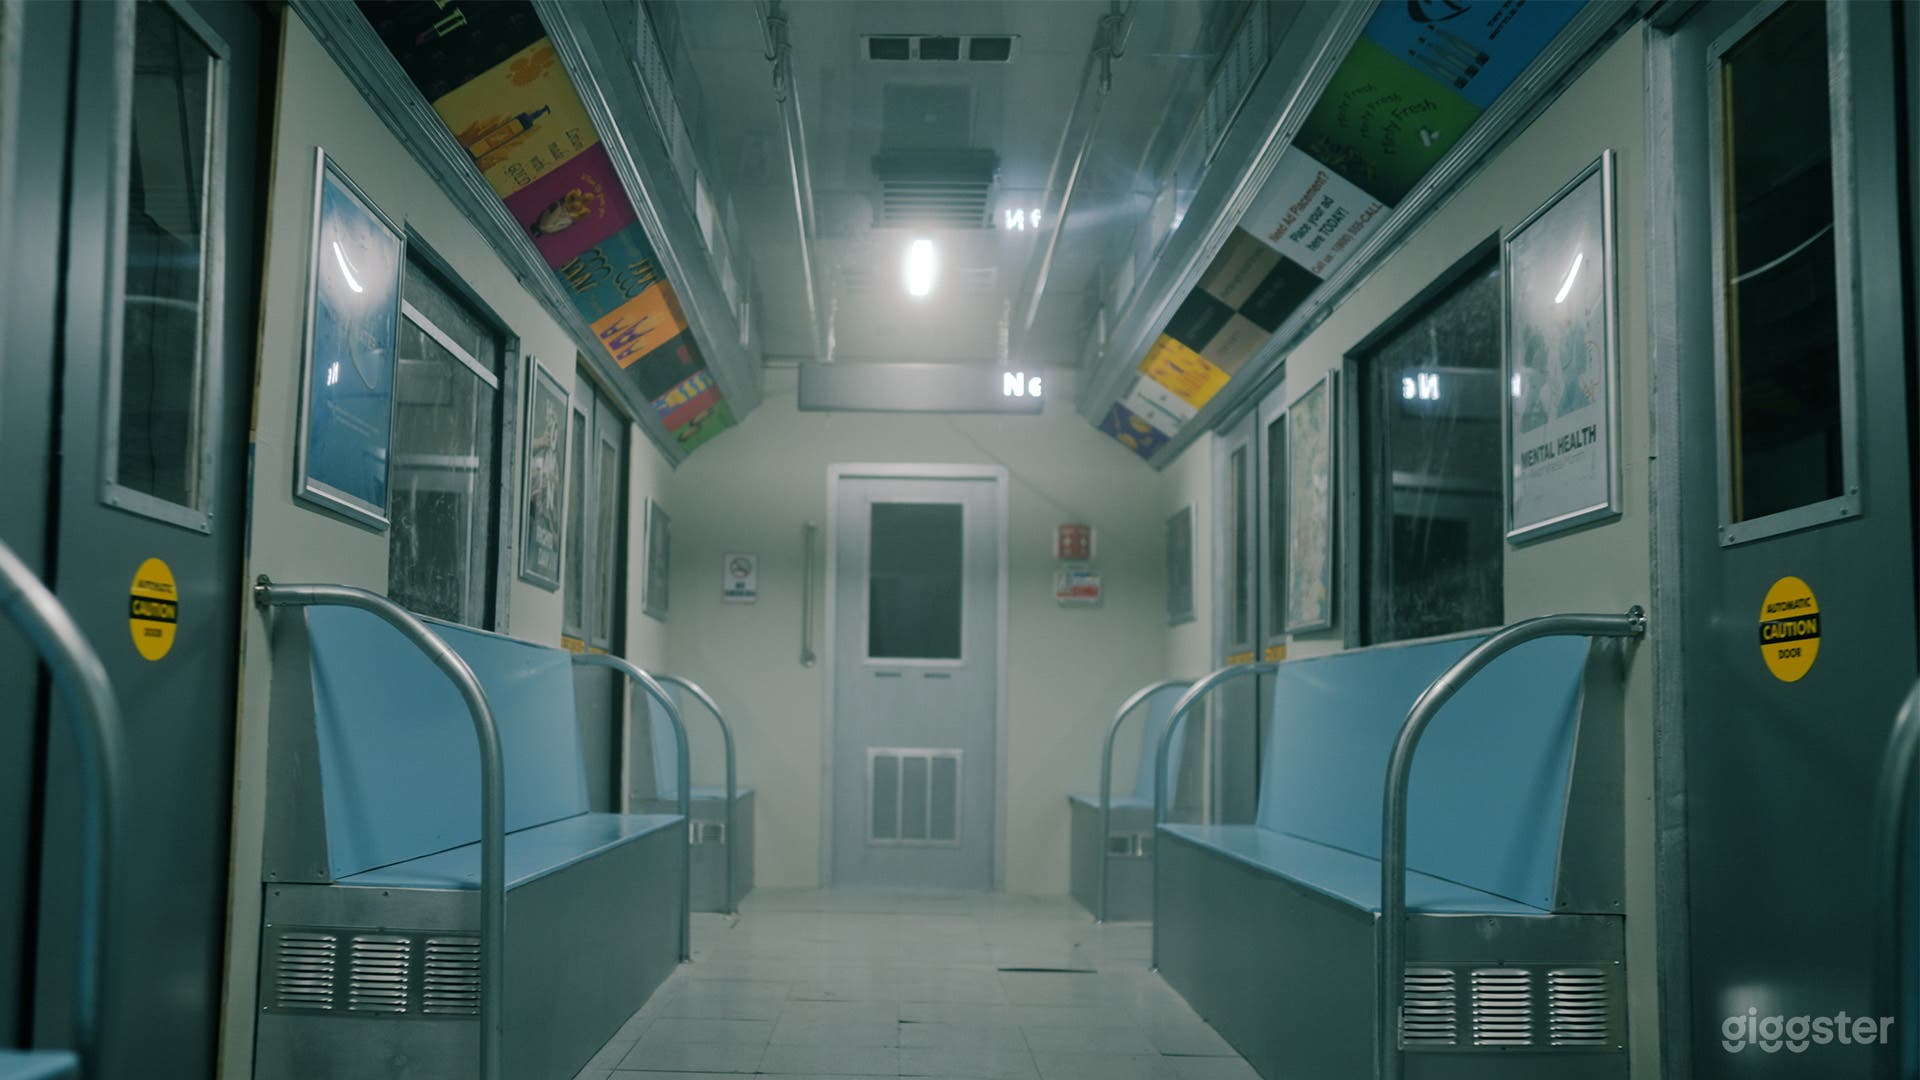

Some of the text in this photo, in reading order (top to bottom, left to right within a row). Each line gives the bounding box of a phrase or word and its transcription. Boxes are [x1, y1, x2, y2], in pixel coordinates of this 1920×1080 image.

[1391, 98, 1438, 120] Fresh
[1289, 170, 1329, 217] Placement?
[1289, 194, 1335, 243] Place your ad
[1306, 206, 1350, 252] here TODAY!
[1520, 441, 1556, 470] MENTAL
[1556, 424, 1597, 456] HEALTH
[131, 599, 176, 619] CAUTION
[1767, 596, 1812, 613] AUTOMATIC
[1763, 618, 1817, 640] CAUTION
[1778, 647, 1802, 660] DOOR
